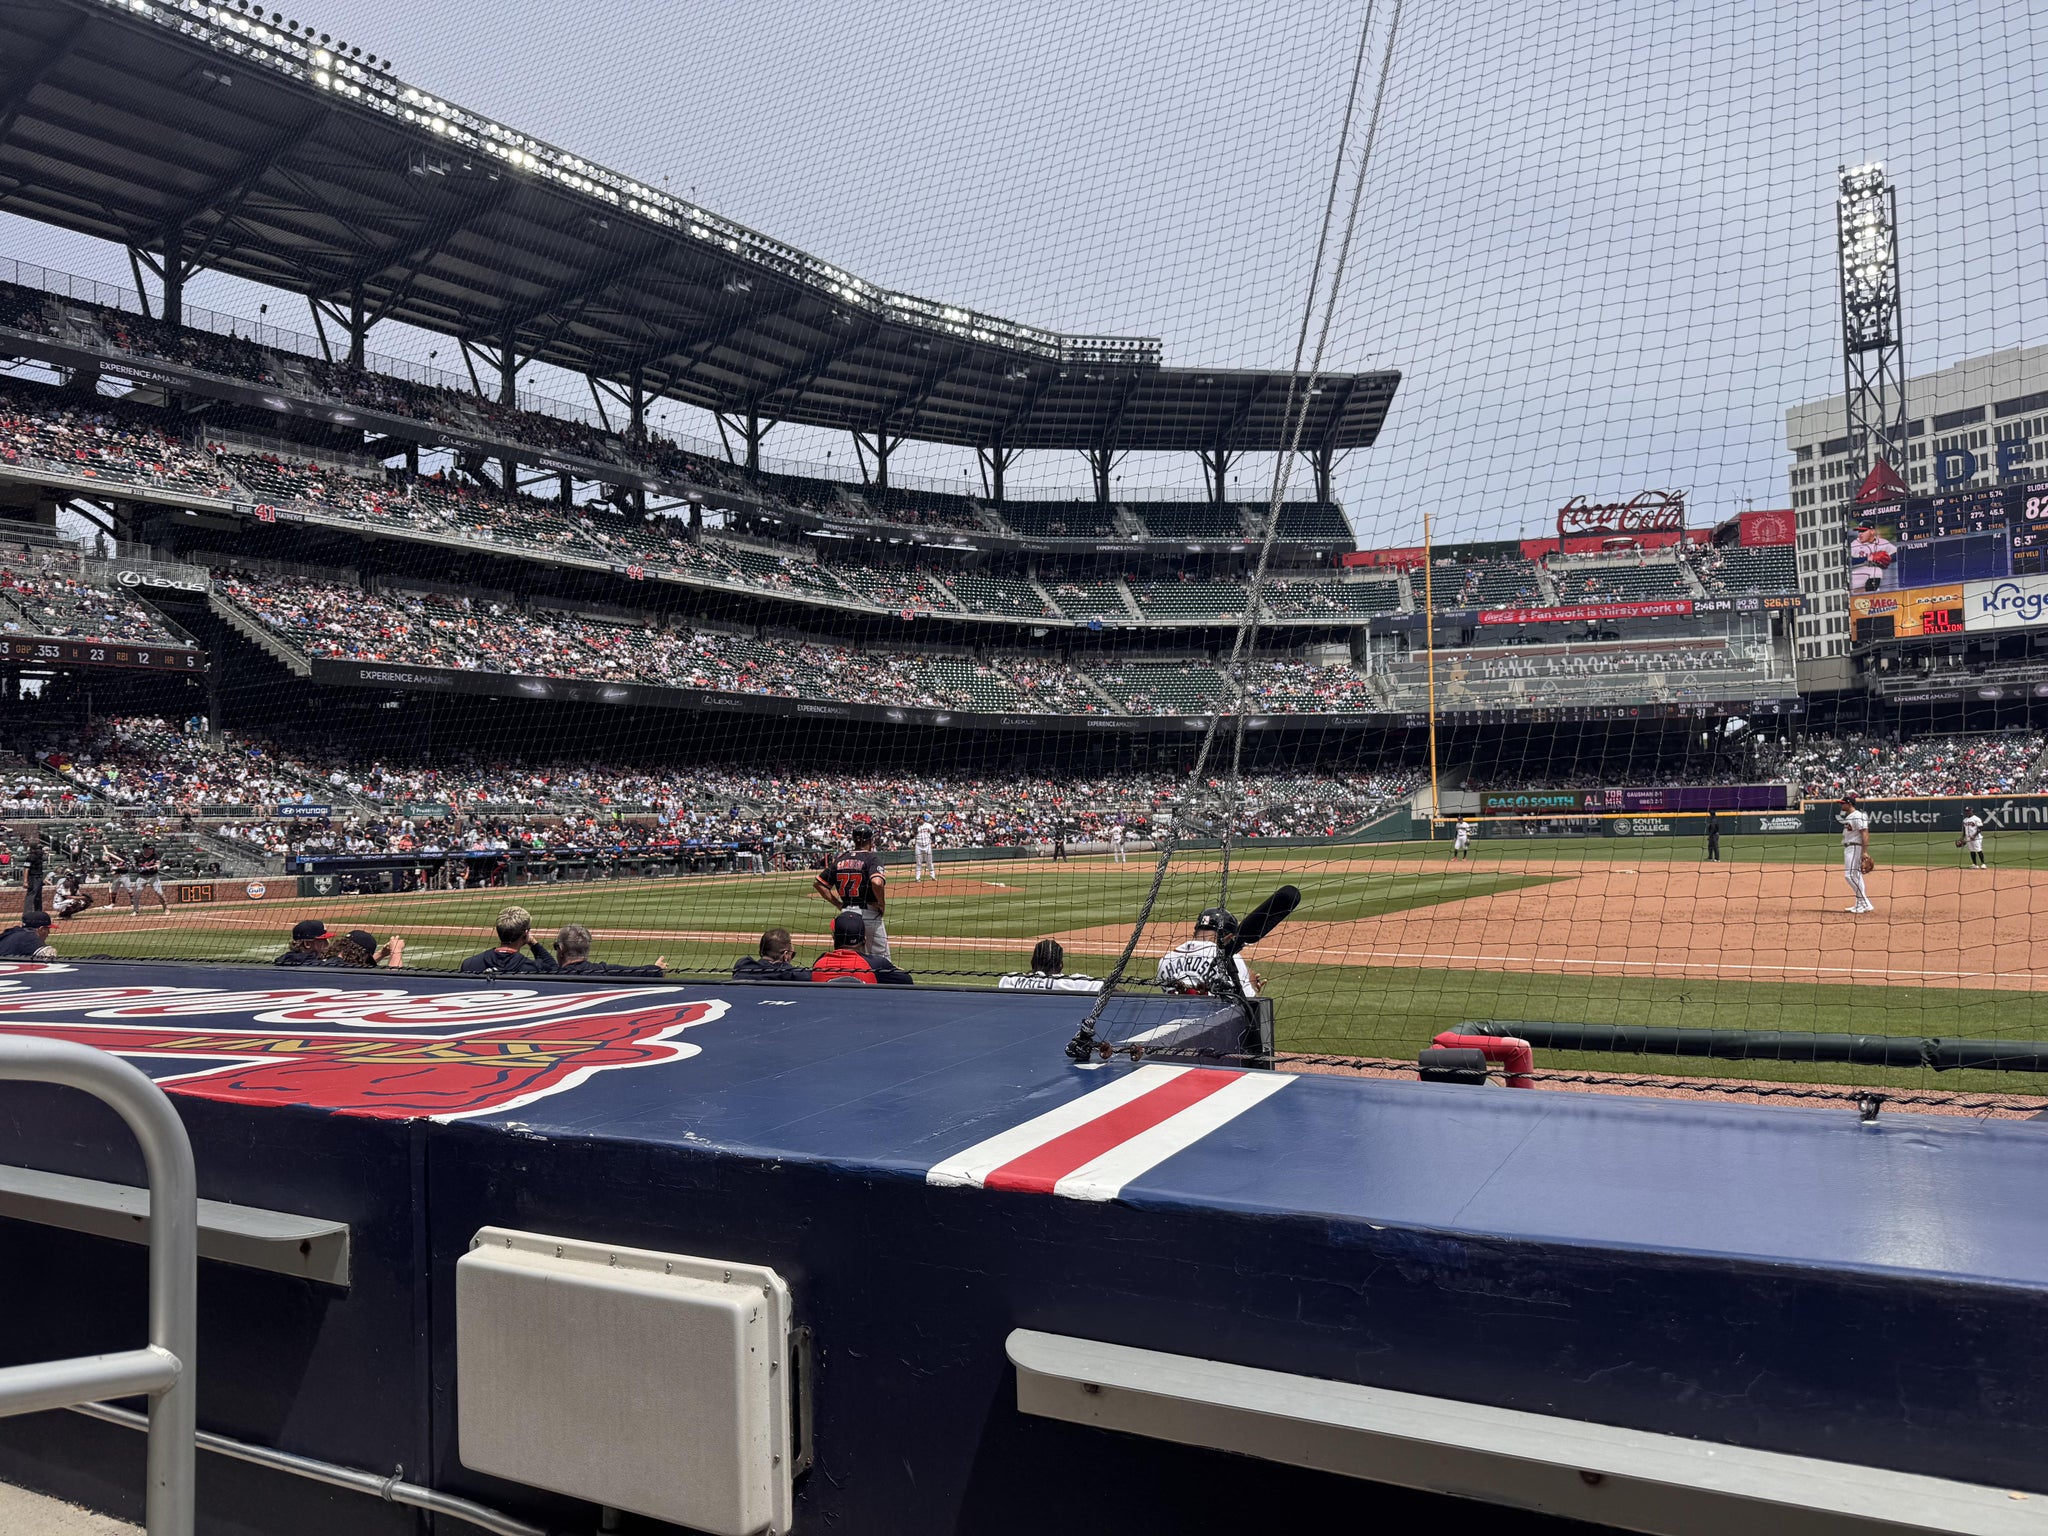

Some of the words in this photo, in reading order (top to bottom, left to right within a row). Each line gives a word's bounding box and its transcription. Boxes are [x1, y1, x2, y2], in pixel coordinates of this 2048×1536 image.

[99, 360, 151, 379] EXPERIENCE
[151, 373, 191, 388] AMAZING
[451, 439, 481, 449] LEXUS
[539, 457, 572, 471] EXPERIENCE
[1933, 498, 1945, 507] LHP
[1962, 494, 1973, 502] 0-1
[1989, 490, 2003, 499] 5.74
[255, 503, 275, 523] 41
[1877, 504, 1901, 515] SUAREZ
[1989, 508, 2004, 516] 45.5
[1902, 532, 1908, 541] 0
[1939, 527, 1945, 536] 3
[1976, 522, 1983, 531] 3
[2026, 550, 2039, 558] VELO
[626, 565, 644, 580] 44
[142, 576, 206, 592] LEXUS
[1694, 601, 1715, 611] 2:46
[1716, 600, 1731, 610] PM
[1763, 597, 1801, 608] $26,615
[1870, 598, 1898, 609] MEGA
[900, 609, 914, 620] 47
[1531, 610, 1552, 619] Fan
[1555, 608, 1585, 618] work
[1587, 607, 1597, 616] is
[1600, 605, 1639, 617] thirsty
[1641, 603, 1672, 613] work
[1924, 610, 1949, 627] 20
[1925, 624, 1963, 634] MILLION
[15, 644, 31, 654] OBP
[34, 645, 60, 657] .353
[72, 649, 78, 657] H
[90, 649, 105, 661] 23
[116, 652, 129, 661] RBI
[138, 652, 149, 664] 12
[165, 656, 174, 665] HR
[187, 656, 194, 667] 5
[1482, 658, 1537, 679] HANK
[1547, 655, 1619, 675] AARON
[1627, 651, 1732, 672] TERRACE
[360, 670, 413, 683] EXPERIENCE
[413, 674, 452, 686] AMAZING
[713, 698, 743, 706] LEXUS
[1894, 694, 1929, 703] EXPERIENCE
[1930, 692, 1960, 700] AMAZING
[797, 704, 828, 713] EXPERIENCE
[1603, 709, 1607, 717] 1
[1618, 709, 1624, 717] 0
[1772, 705, 1778, 713] 3
[1605, 790, 1622, 798] TOR
[1487, 796, 1514, 808] GAS
[1530, 795, 1574, 807] SOUTH
[1584, 794, 1601, 806] AL
[1605, 797, 1622, 805] MIN
[1866, 810, 1940, 824] Wellstar
[1632, 824, 1670, 832] COLLEGE
[836, 872, 862, 897] 77
[181, 885, 212, 902] 0:09
[248, 887, 265, 895] Gulf
